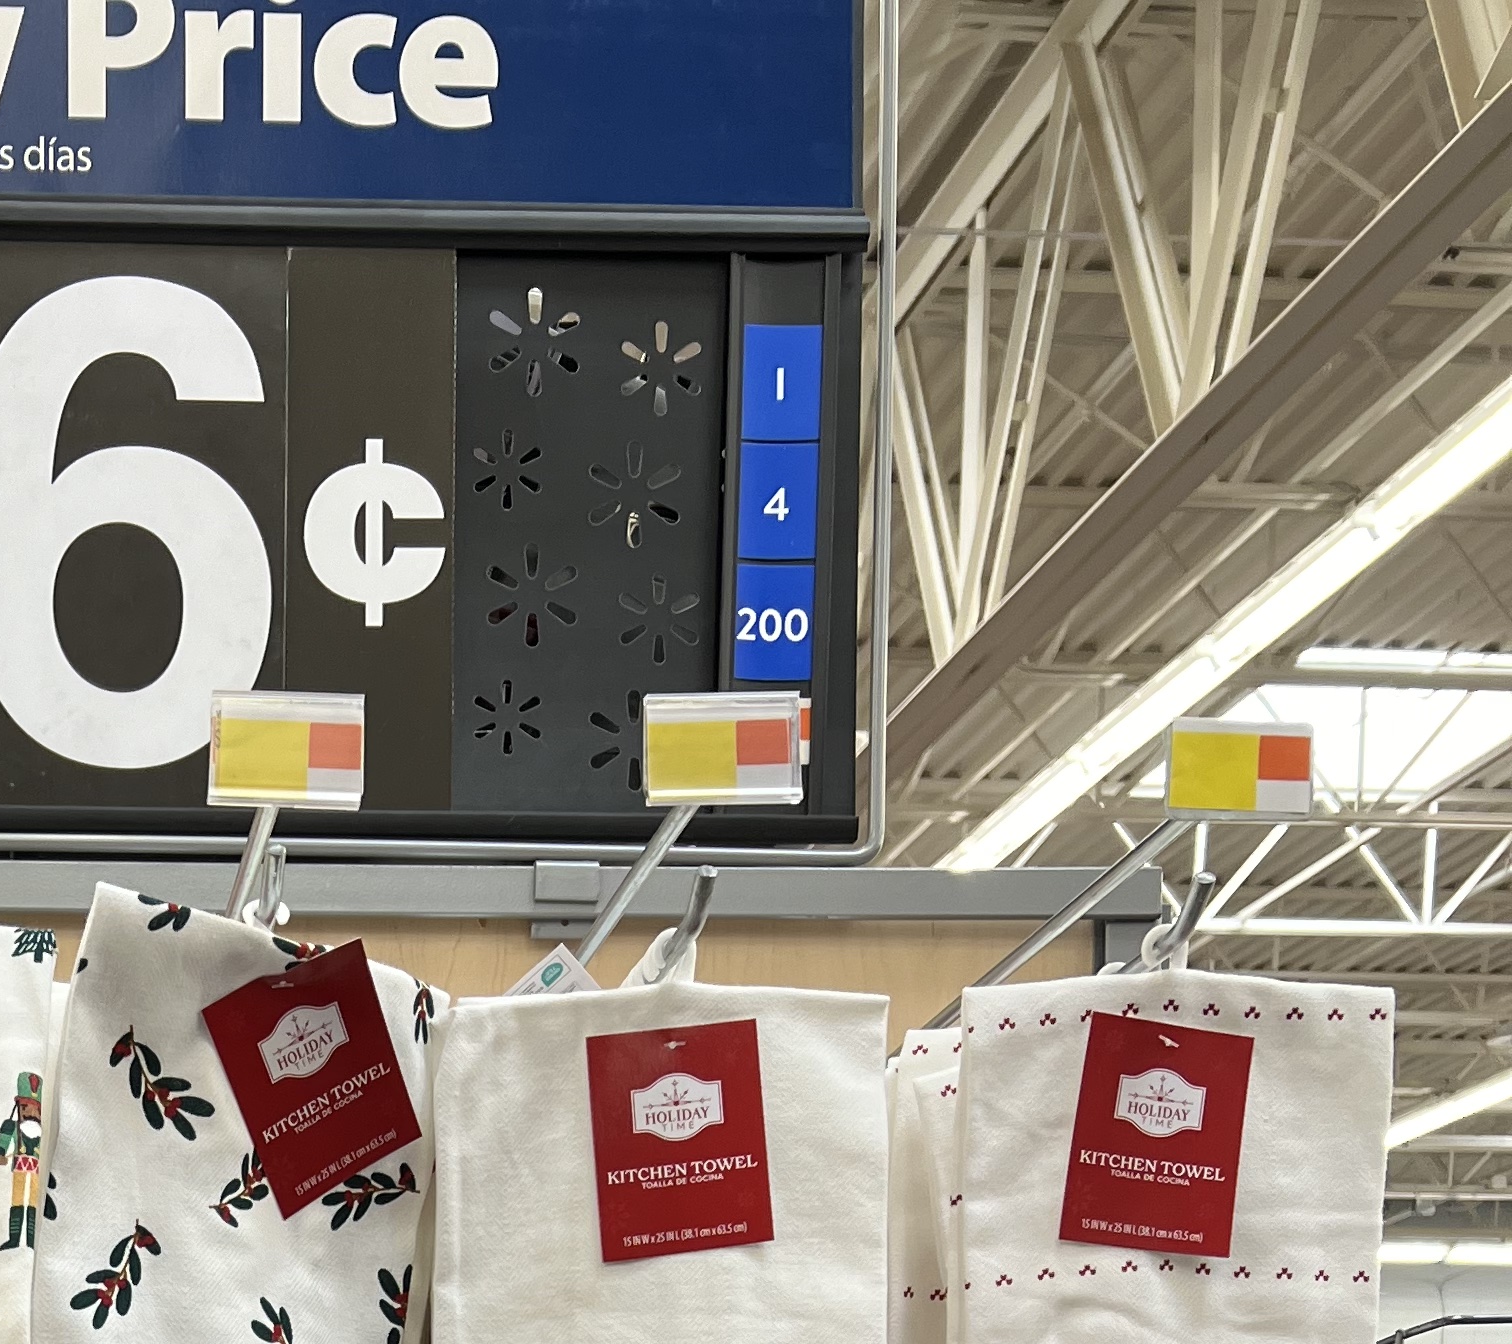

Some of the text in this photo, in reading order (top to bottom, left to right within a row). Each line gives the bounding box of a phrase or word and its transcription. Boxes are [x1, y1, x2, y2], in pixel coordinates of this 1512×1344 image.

[23, 136, 93, 172] días
[763, 487, 789, 521] 4
[736, 608, 809, 642] 200
[277, 1031, 336, 1071] HOLIDAY
[295, 1052, 324, 1070] TIME
[262, 1060, 390, 1144] KITCHEN TOWEL
[294, 1090, 363, 1134] TOALLA DE COCINA
[645, 1106, 709, 1125] HOLIDAY
[1128, 1101, 1191, 1121] HOLIDAY
[663, 1122, 694, 1132] TIME
[1142, 1117, 1173, 1128] TIME
[608, 1154, 758, 1185] KITCHEN TOWEL
[642, 1179, 673, 1189] TOALLA
[690, 1173, 723, 1183] COCINA
[1079, 1150, 1226, 1181] KITCHEN TOWEL
[1111, 1170, 1141, 1180] TOALLA
[1157, 1175, 1190, 1185] COCINA
